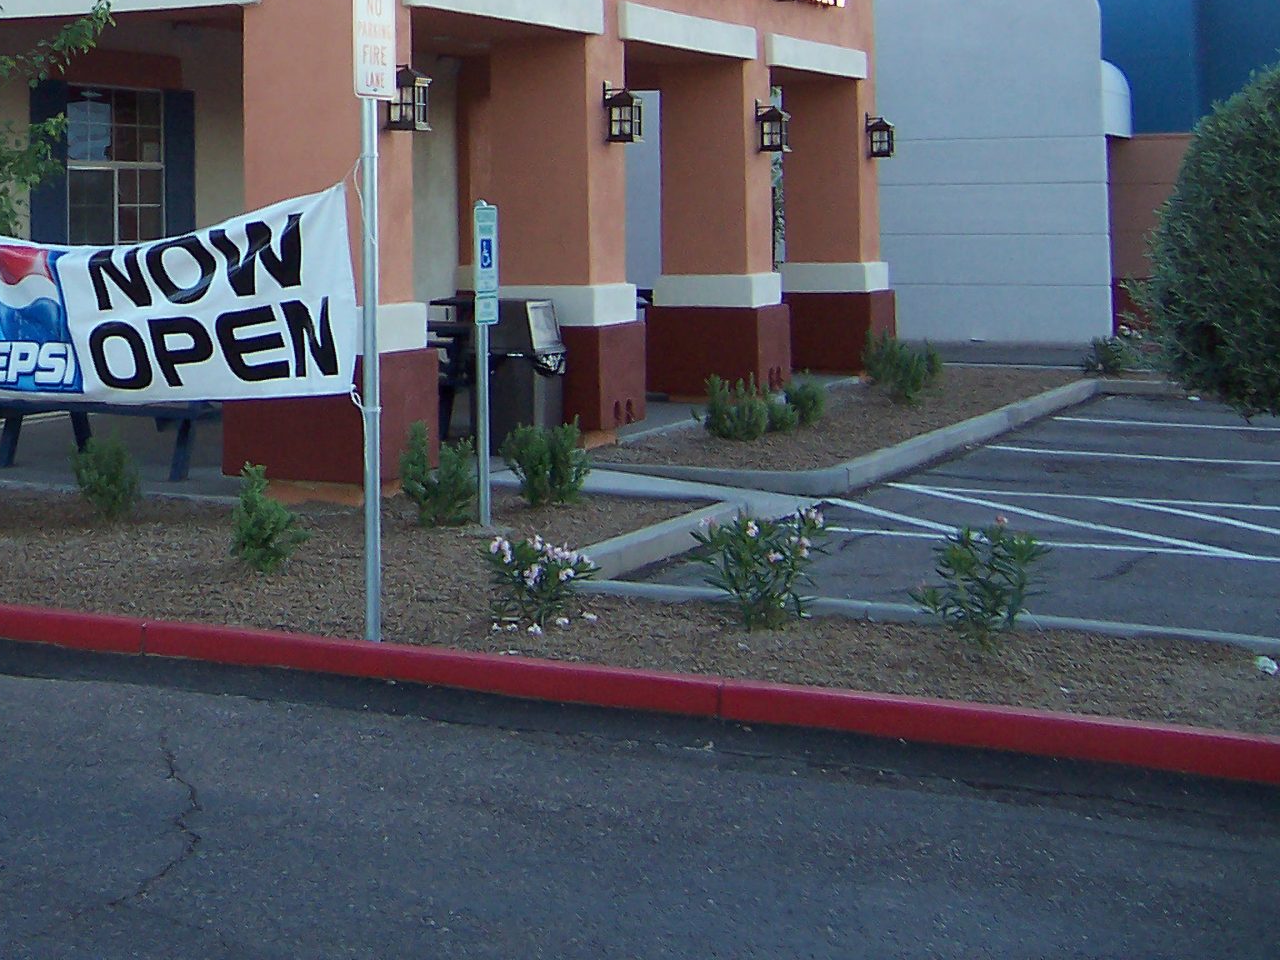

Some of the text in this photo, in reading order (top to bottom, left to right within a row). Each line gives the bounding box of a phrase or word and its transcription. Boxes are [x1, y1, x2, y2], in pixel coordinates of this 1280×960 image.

[362, 44, 387, 66] FIRE
[365, 71, 385, 89] LANE
[88, 212, 304, 311] NOW
[89, 297, 339, 390] OPEN
